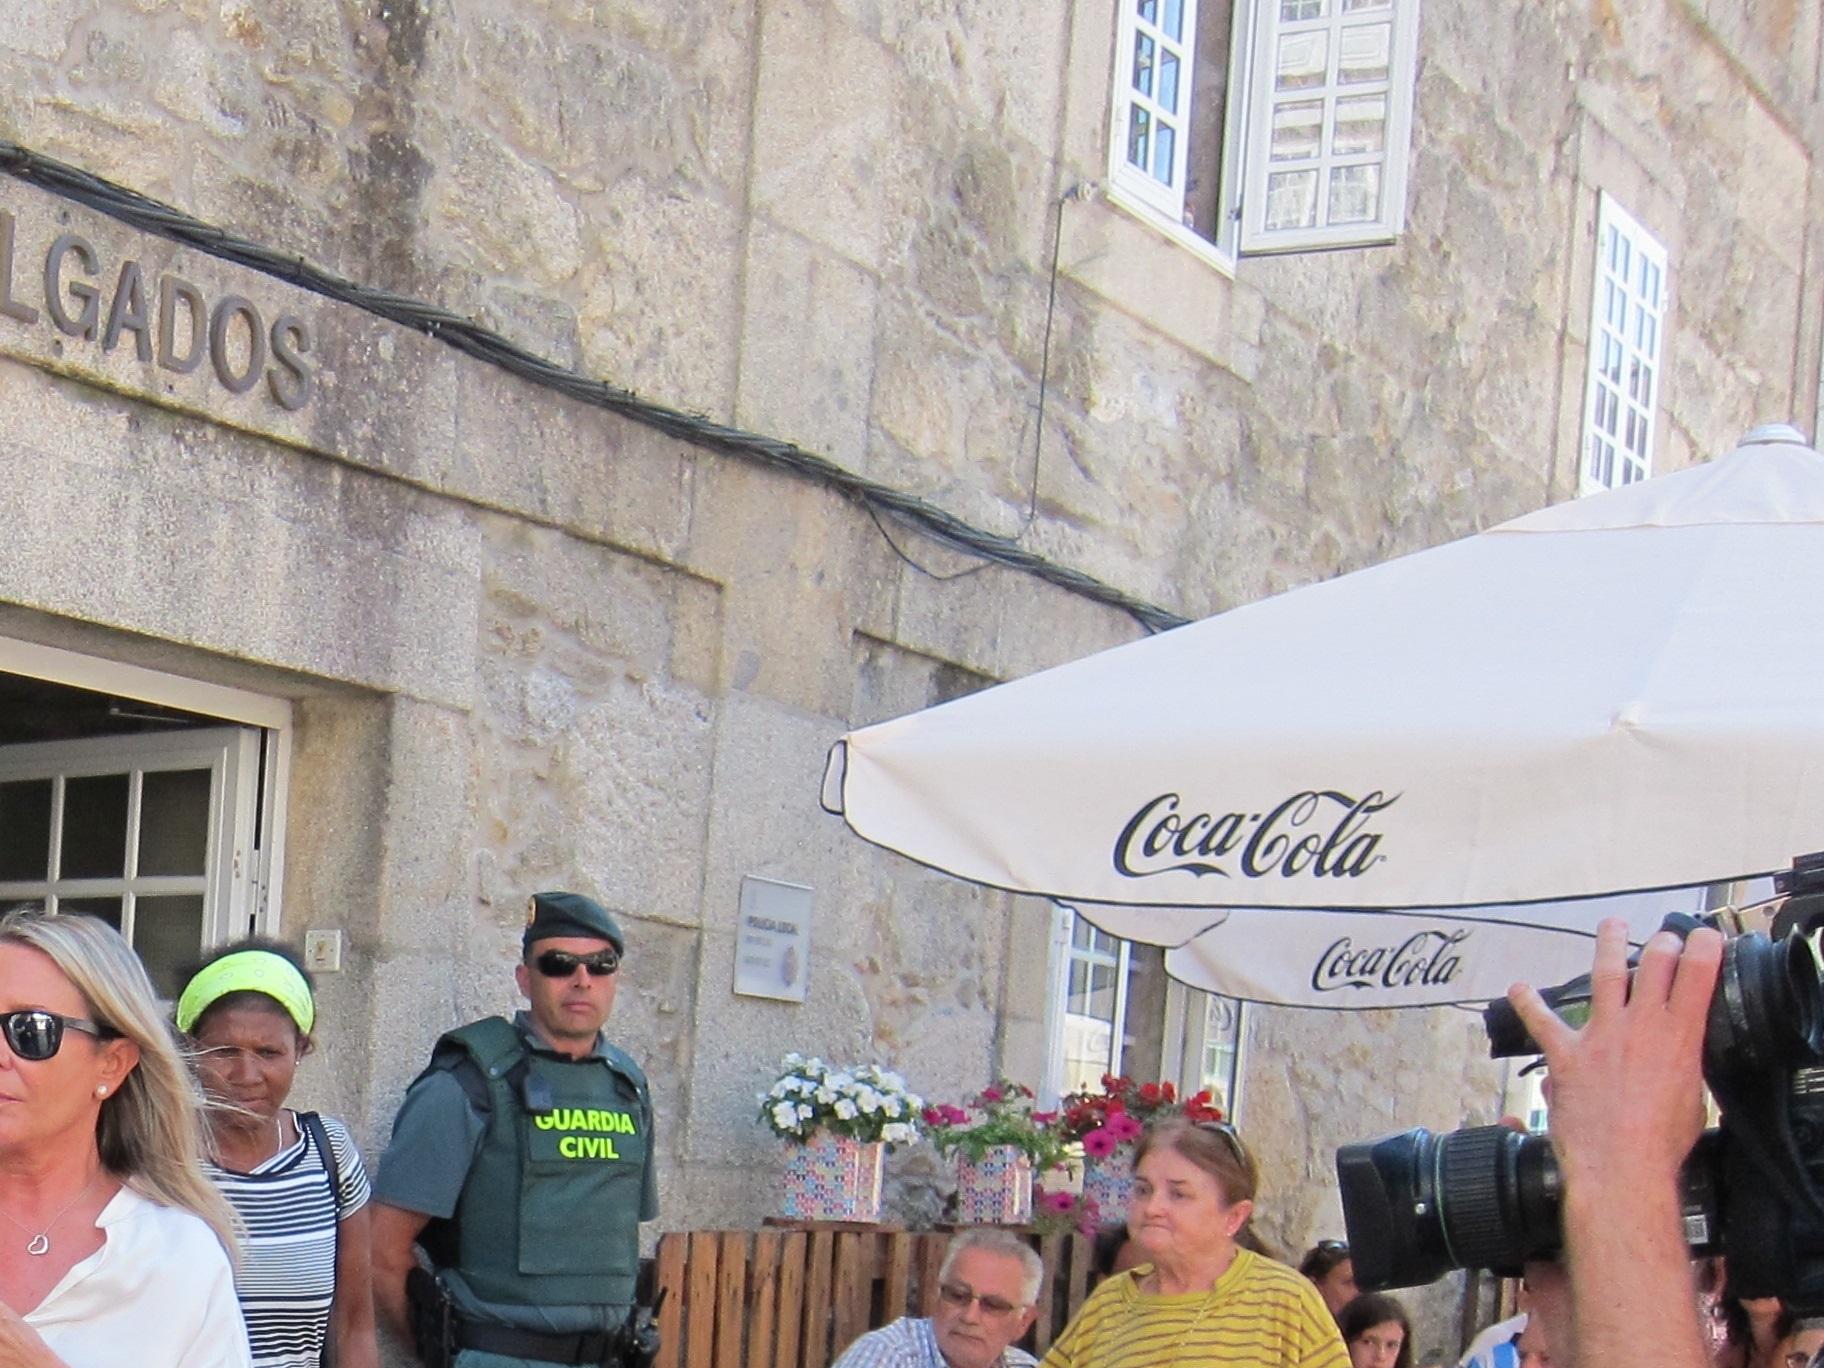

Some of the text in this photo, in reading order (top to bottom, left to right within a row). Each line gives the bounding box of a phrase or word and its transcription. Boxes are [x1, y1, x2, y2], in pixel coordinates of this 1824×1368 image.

[1113, 790, 1402, 878] Coca-Cola
[1312, 929, 1472, 992] Coca-Cola
[534, 1108, 636, 1135] GUARDIA
[559, 1136, 620, 1160] CIVIL
